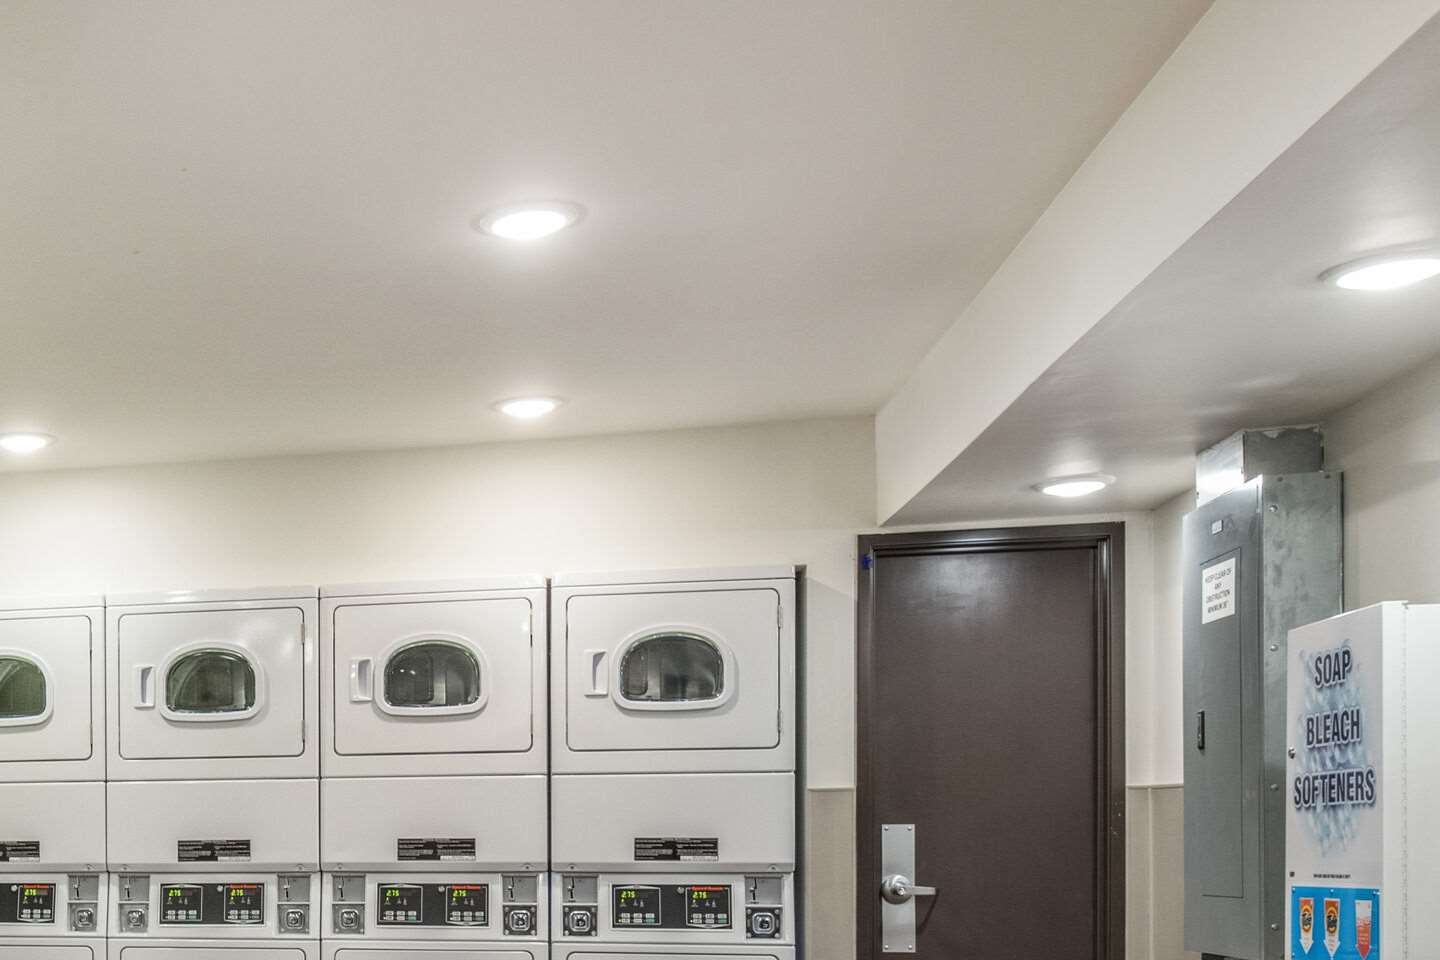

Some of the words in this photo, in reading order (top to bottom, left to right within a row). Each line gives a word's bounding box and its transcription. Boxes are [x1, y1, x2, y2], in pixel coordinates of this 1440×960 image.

[1315, 649, 1351, 686] SOAP
[1306, 708, 1360, 746] BLEACH
[1294, 769, 1375, 805] SOFTENERS
